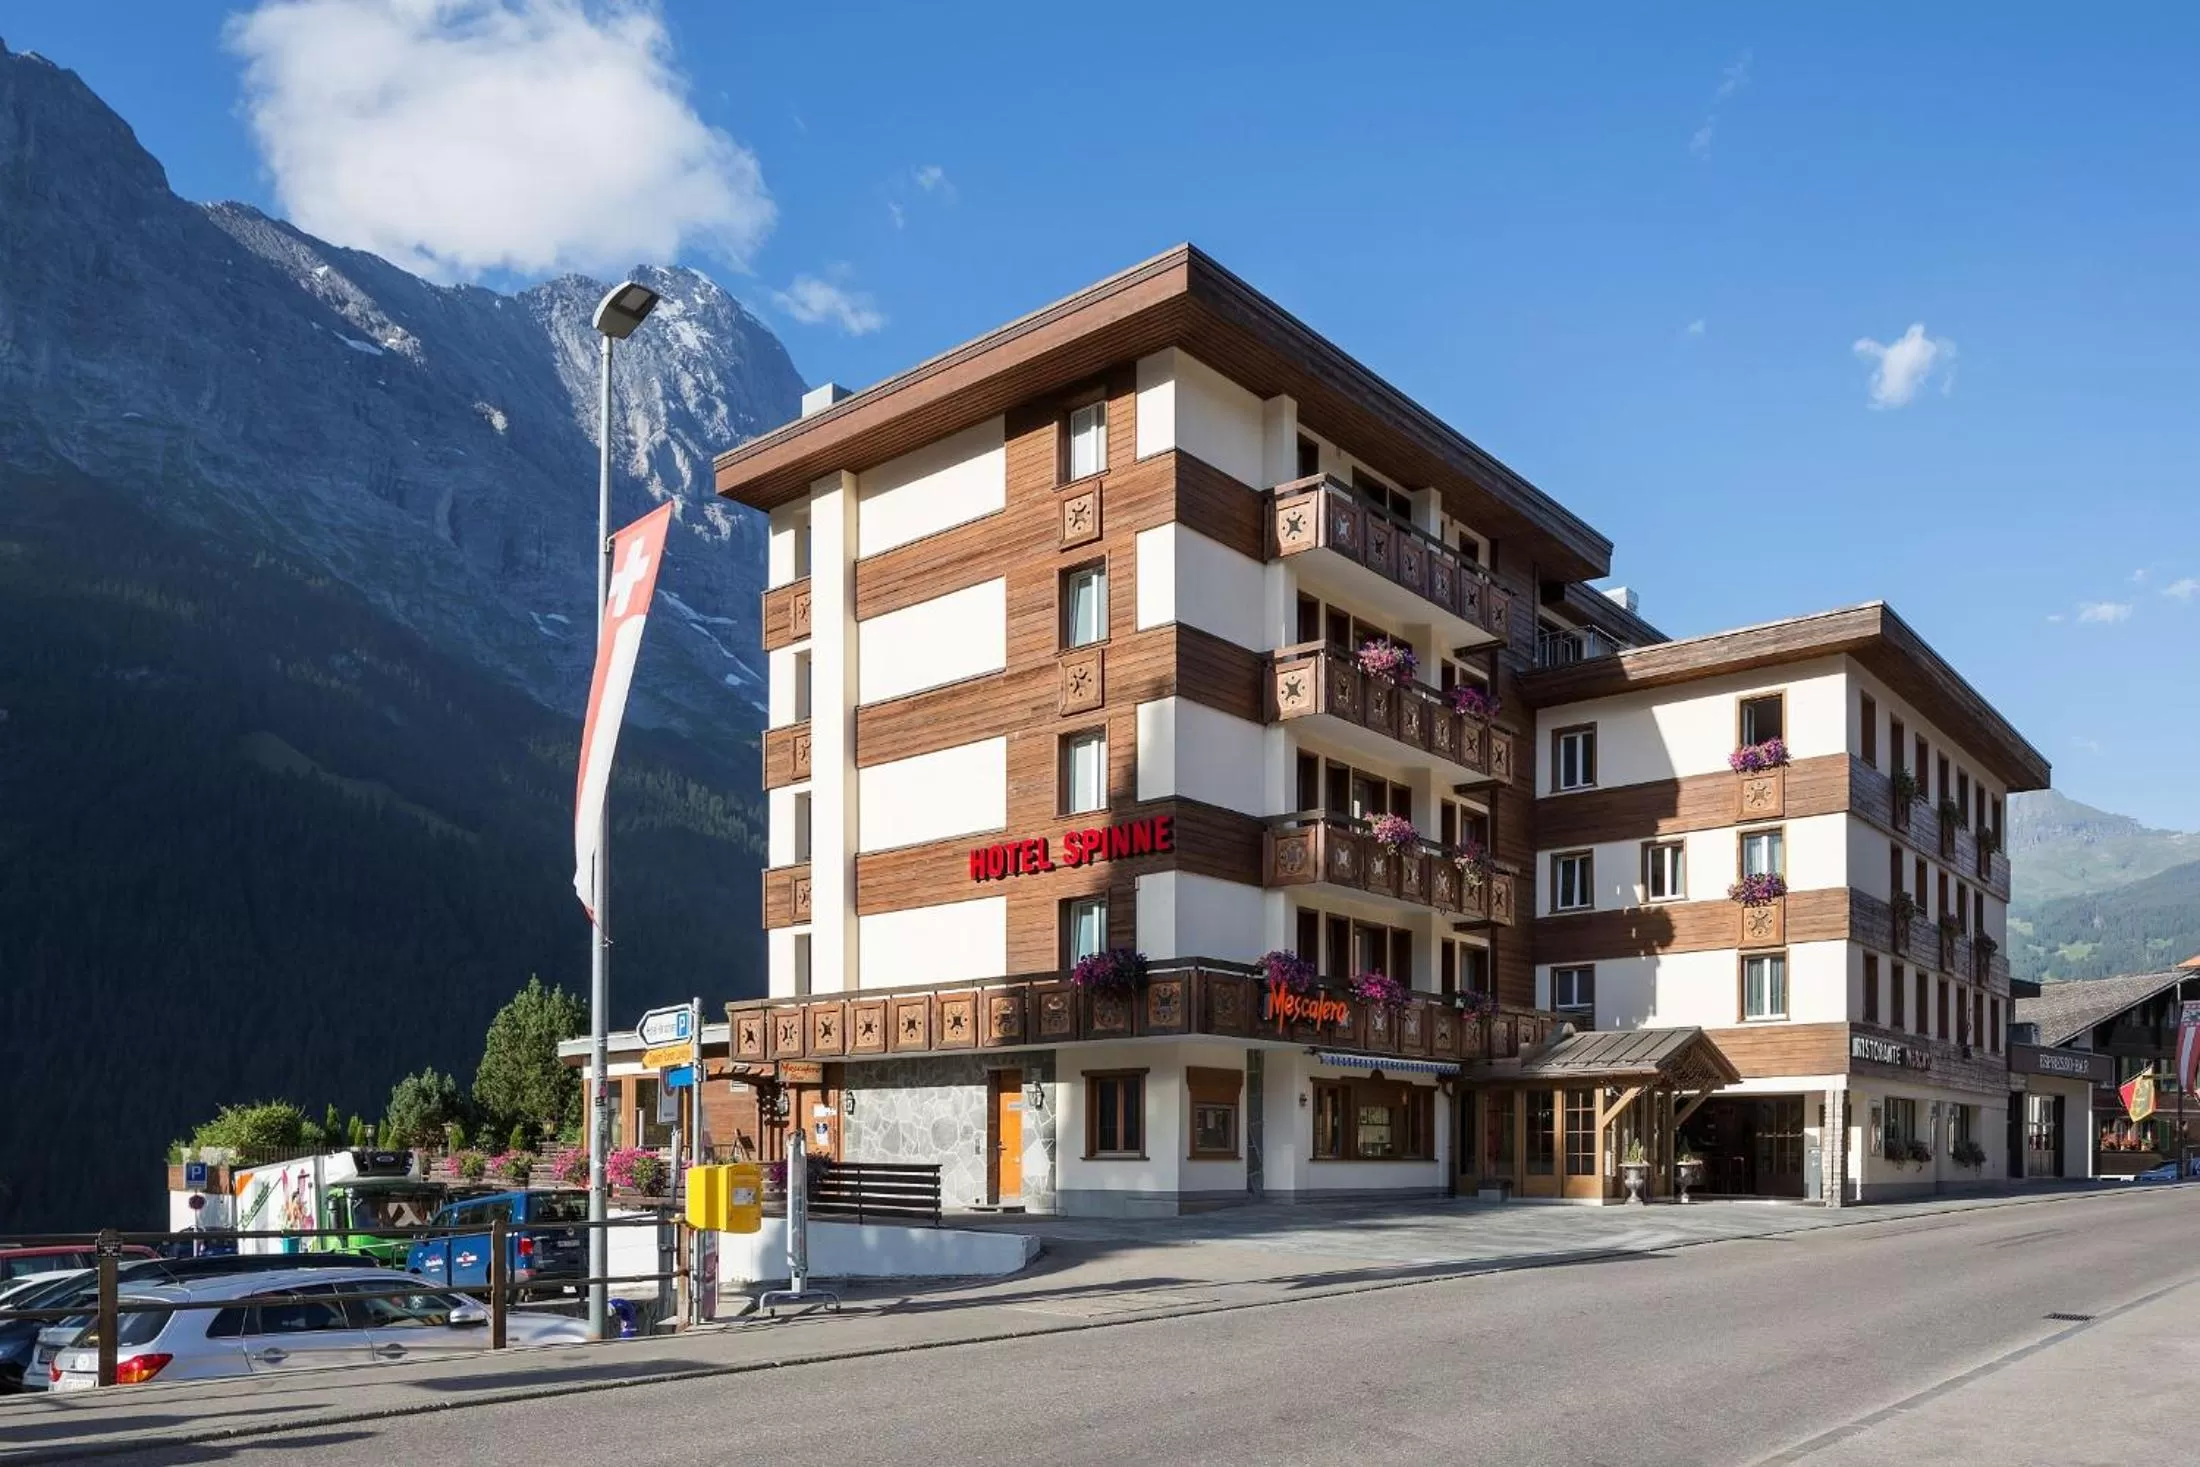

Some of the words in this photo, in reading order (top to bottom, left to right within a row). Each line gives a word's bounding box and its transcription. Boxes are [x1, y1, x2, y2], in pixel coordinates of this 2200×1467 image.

[970, 837, 1053, 881] HOTEL
[1062, 815, 1172, 866] SPINNE
[1268, 981, 1347, 1035] Mescalero
[192, 1165, 202, 1181] P
